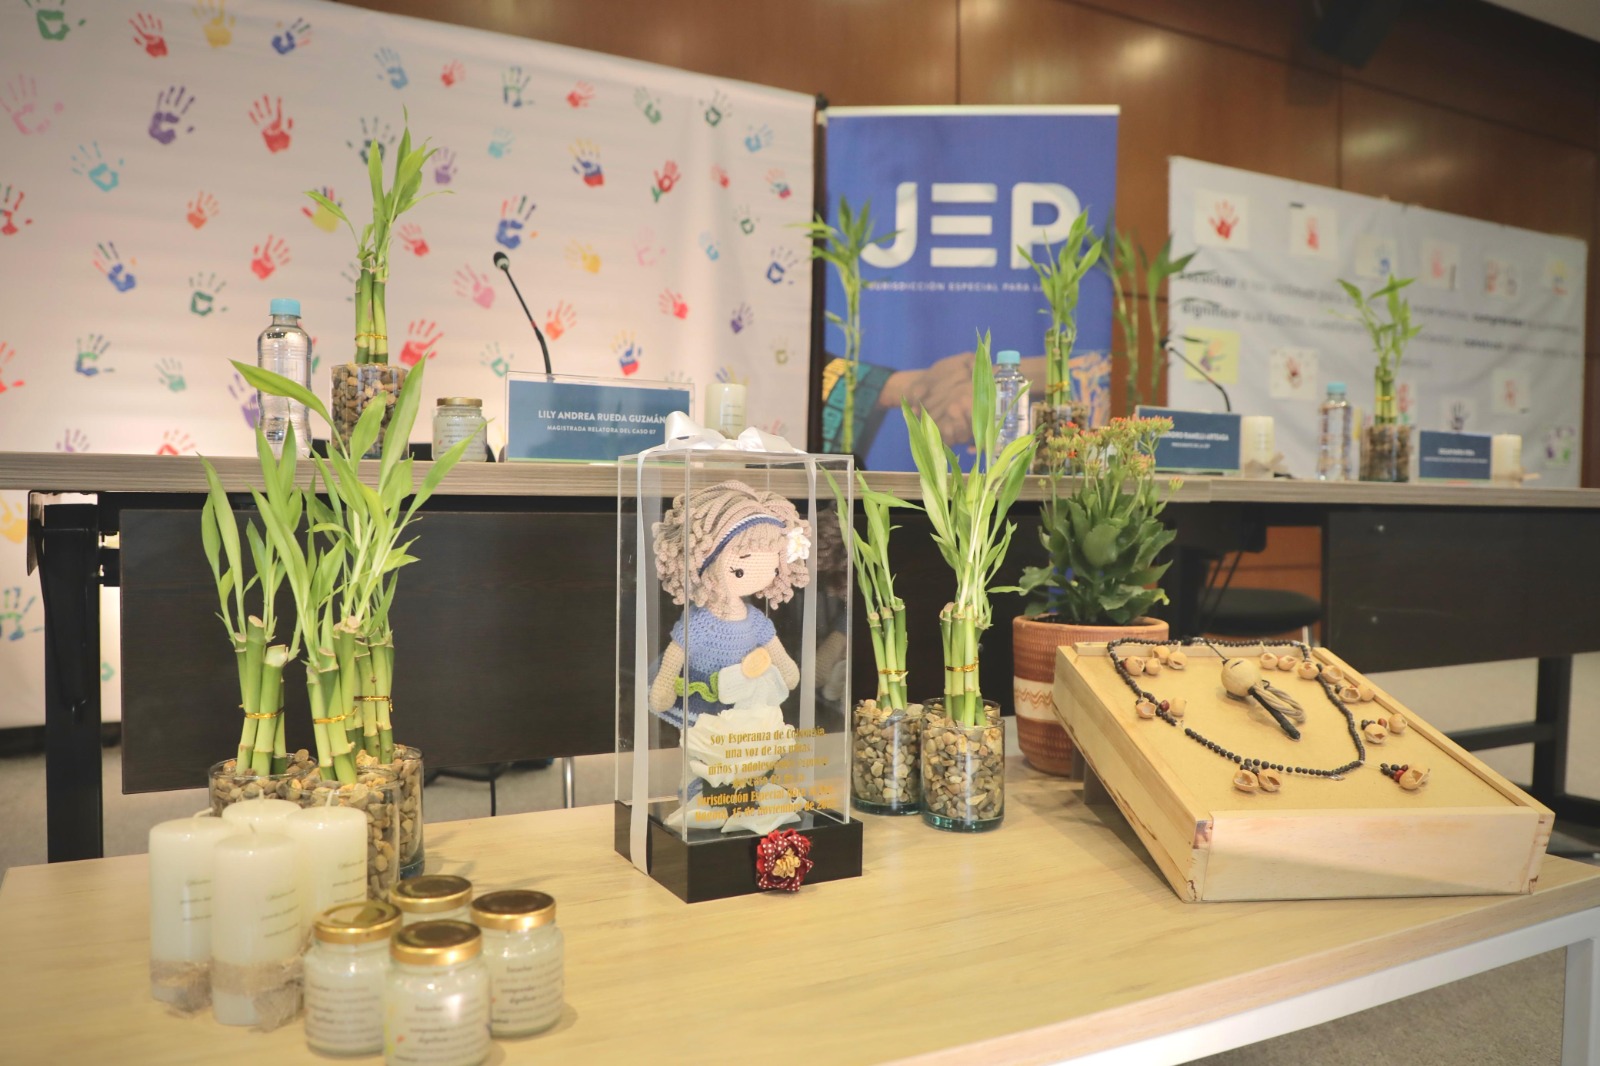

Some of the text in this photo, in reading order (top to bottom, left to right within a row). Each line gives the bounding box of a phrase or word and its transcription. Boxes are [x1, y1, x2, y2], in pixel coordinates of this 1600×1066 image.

[860, 182, 1082, 270] JEP
[949, 281, 998, 292] ESPECIAL
[1002, 282, 1030, 292] PARA
[538, 410, 666, 424] LILY ANDREA RUEDA GUZMÁN
[710, 734, 725, 746] Soy
[728, 730, 771, 744] Esperanza
[774, 729, 784, 740] de
[725, 748, 742, 758] una
[745, 747, 758, 757] voz
[761, 746, 771, 756] de
[774, 744, 786, 755] las
[708, 763, 732, 775] niños
[734, 764, 739, 774] y
